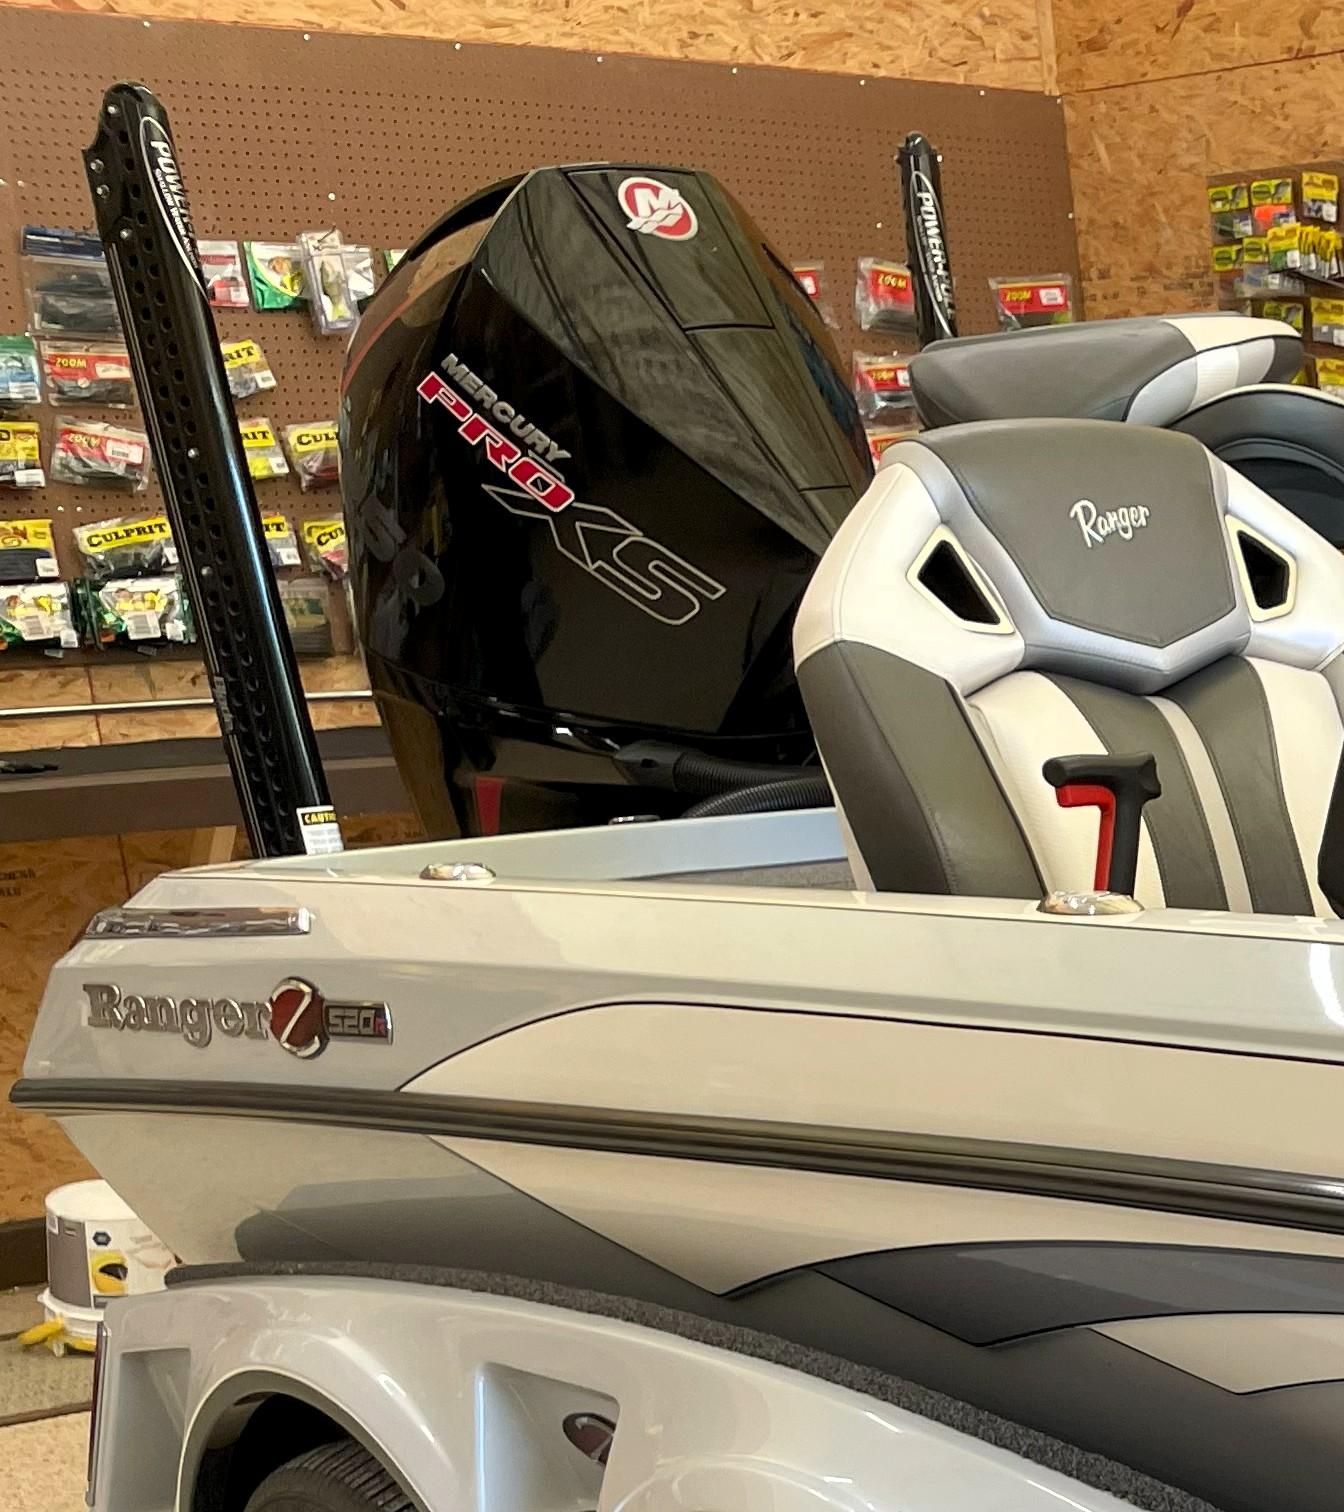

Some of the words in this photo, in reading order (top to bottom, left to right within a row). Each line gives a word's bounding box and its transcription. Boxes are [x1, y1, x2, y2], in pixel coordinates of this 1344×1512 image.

[417, 371, 575, 512] PRO
[441, 353, 572, 462] MERCURY
[87, 523, 166, 548] CULPRIT
[481, 449, 727, 625] XS
[1069, 499, 1150, 548] Ranger
[83, 983, 272, 1048] Ranger
